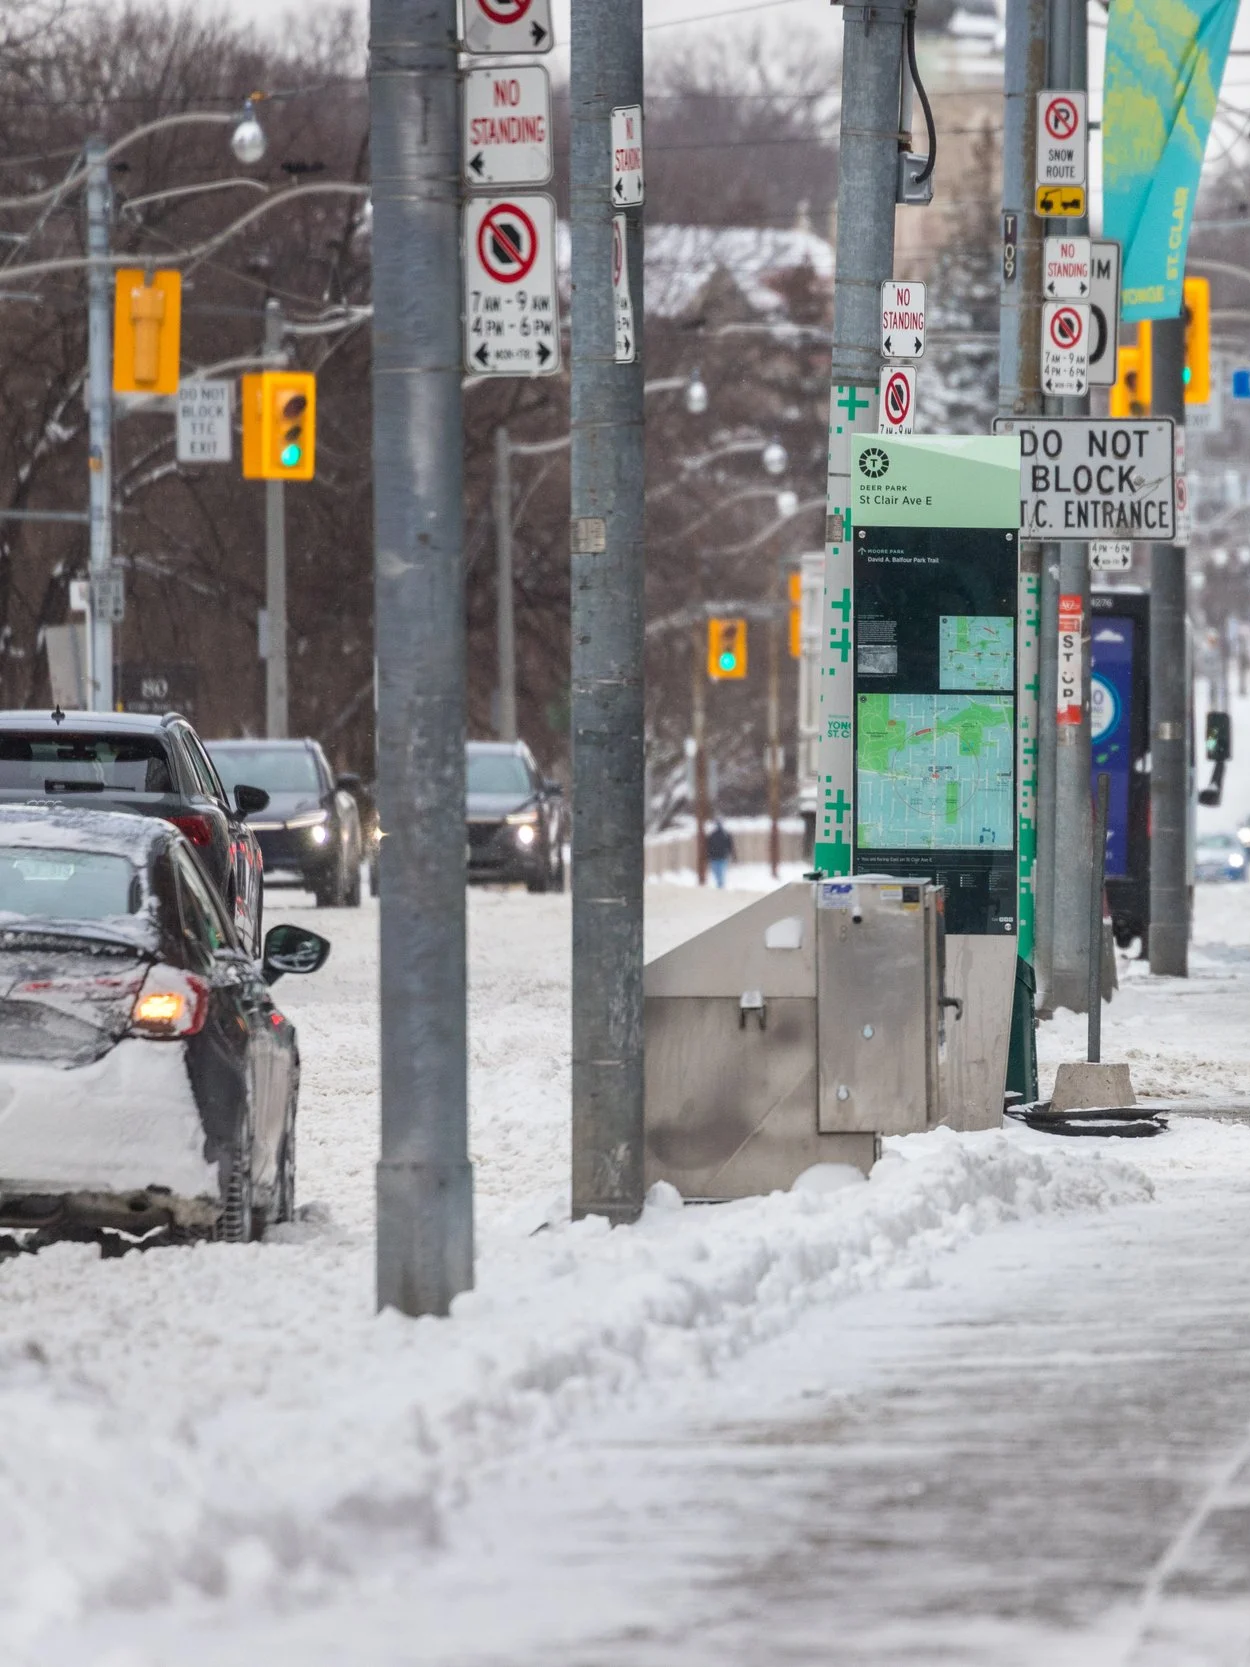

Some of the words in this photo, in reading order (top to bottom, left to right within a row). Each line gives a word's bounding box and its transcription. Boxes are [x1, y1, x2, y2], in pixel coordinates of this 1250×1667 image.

[493, 79, 520, 107] NO
[471, 115, 545, 145] STANDING
[1048, 149, 1074, 161] SNOW
[1046, 165, 1076, 179] ROUTE
[1060, 244, 1075, 258] NO
[1047, 262, 1088, 278] STANDING
[472, 290, 481, 312] 7
[896, 288, 910, 306] NO
[472, 315, 482, 336] 4
[520, 315, 531, 337] 6
[883, 311, 923, 330] STANDING
[1045, 352, 1050, 364] 7
[1051, 355, 1060, 364] AM
[1069, 352, 1074, 364] 9
[1076, 355, 1085, 364] AM
[1044, 365, 1050, 377] 4
[1051, 367, 1061, 377] PM
[1069, 366, 1074, 377] 6
[1076, 367, 1085, 377] PM
[201, 388, 225, 401] NOT
[182, 406, 225, 418] BLOCK
[190, 441, 217, 455] EXIT
[1020, 430, 1063, 458] DO
[1088, 430, 1149, 458] NOT
[1032, 465, 1136, 494] BLOCK
[859, 494, 870, 505] St
[874, 495, 898, 505] Clair
[902, 496, 922, 506] Ave
[926, 496, 932, 506] E
[1064, 500, 1169, 529] ENTRANCE
[1092, 543, 1097, 552] 4
[1099, 544, 1107, 553] PM
[1115, 543, 1120, 553] 6
[1121, 544, 1130, 552] PM
